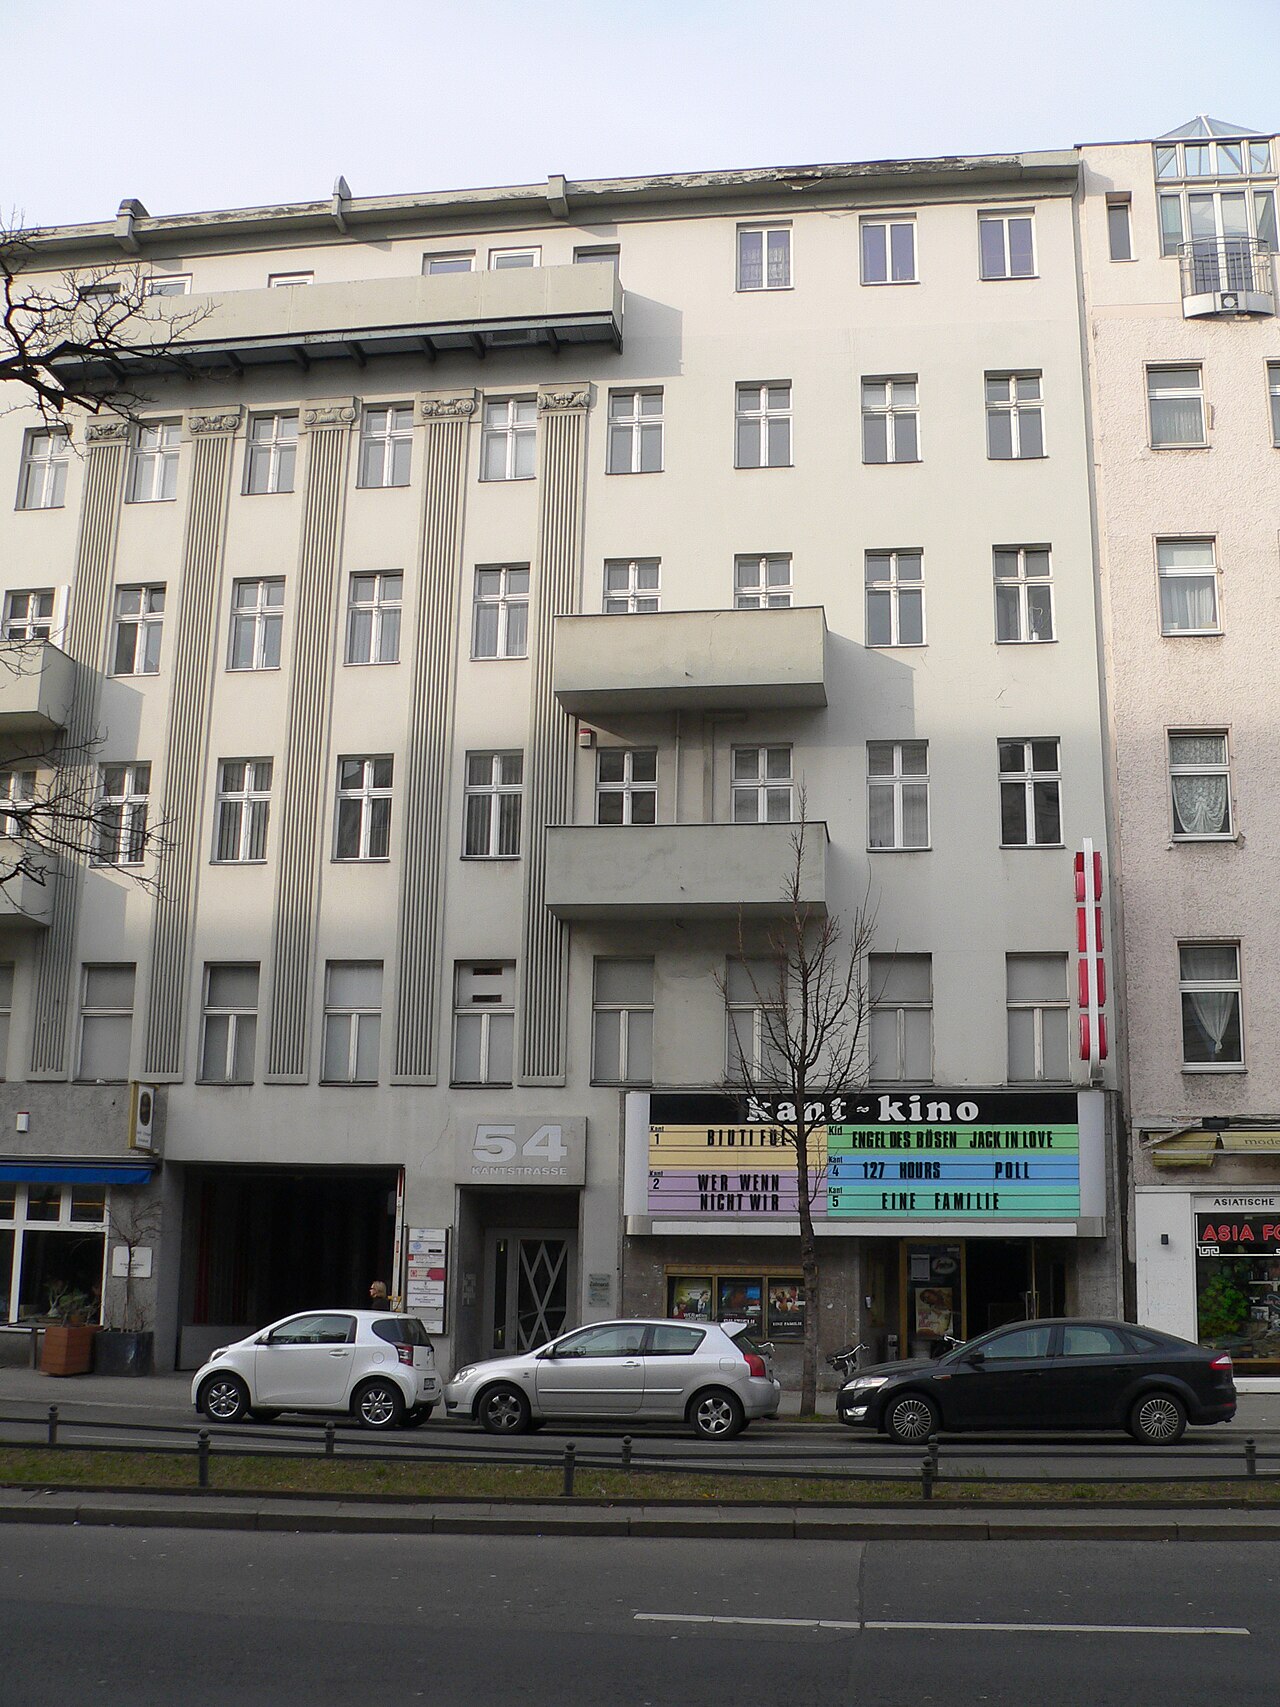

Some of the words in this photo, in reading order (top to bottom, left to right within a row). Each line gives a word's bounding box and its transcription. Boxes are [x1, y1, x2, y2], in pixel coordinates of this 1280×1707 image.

[746, 1096, 847, 1122] kant
[878, 1095, 979, 1122] kino
[471, 1123, 568, 1163] 54
[654, 1133, 660, 1145] 1
[707, 1129, 788, 1146] BIUTIFUL
[852, 1131, 886, 1148] ENGEL
[889, 1131, 911, 1148] DES
[917, 1129, 957, 1148] BÖSEN
[969, 1131, 1001, 1148] JACK
[1005, 1131, 1019, 1148] IN
[1023, 1131, 1053, 1148] LOVE
[471, 1166, 568, 1176] KANTSTRASSE
[832, 1165, 839, 1176] 4
[863, 1162, 885, 1179] 127
[900, 1162, 941, 1179] HOURS
[995, 1162, 1030, 1179] POLL
[652, 1178, 660, 1190] 2
[697, 1174, 728, 1191] WER
[740, 1174, 779, 1191] WENN
[700, 1194, 743, 1211] NICHT
[750, 1194, 779, 1211] WIR
[832, 1195, 839, 1207] 5
[882, 1193, 916, 1210] EINE
[935, 1193, 999, 1210] FAMILIE
[1213, 1198, 1275, 1206] ASIATISCHE
[1202, 1224, 1255, 1242] ASIA
